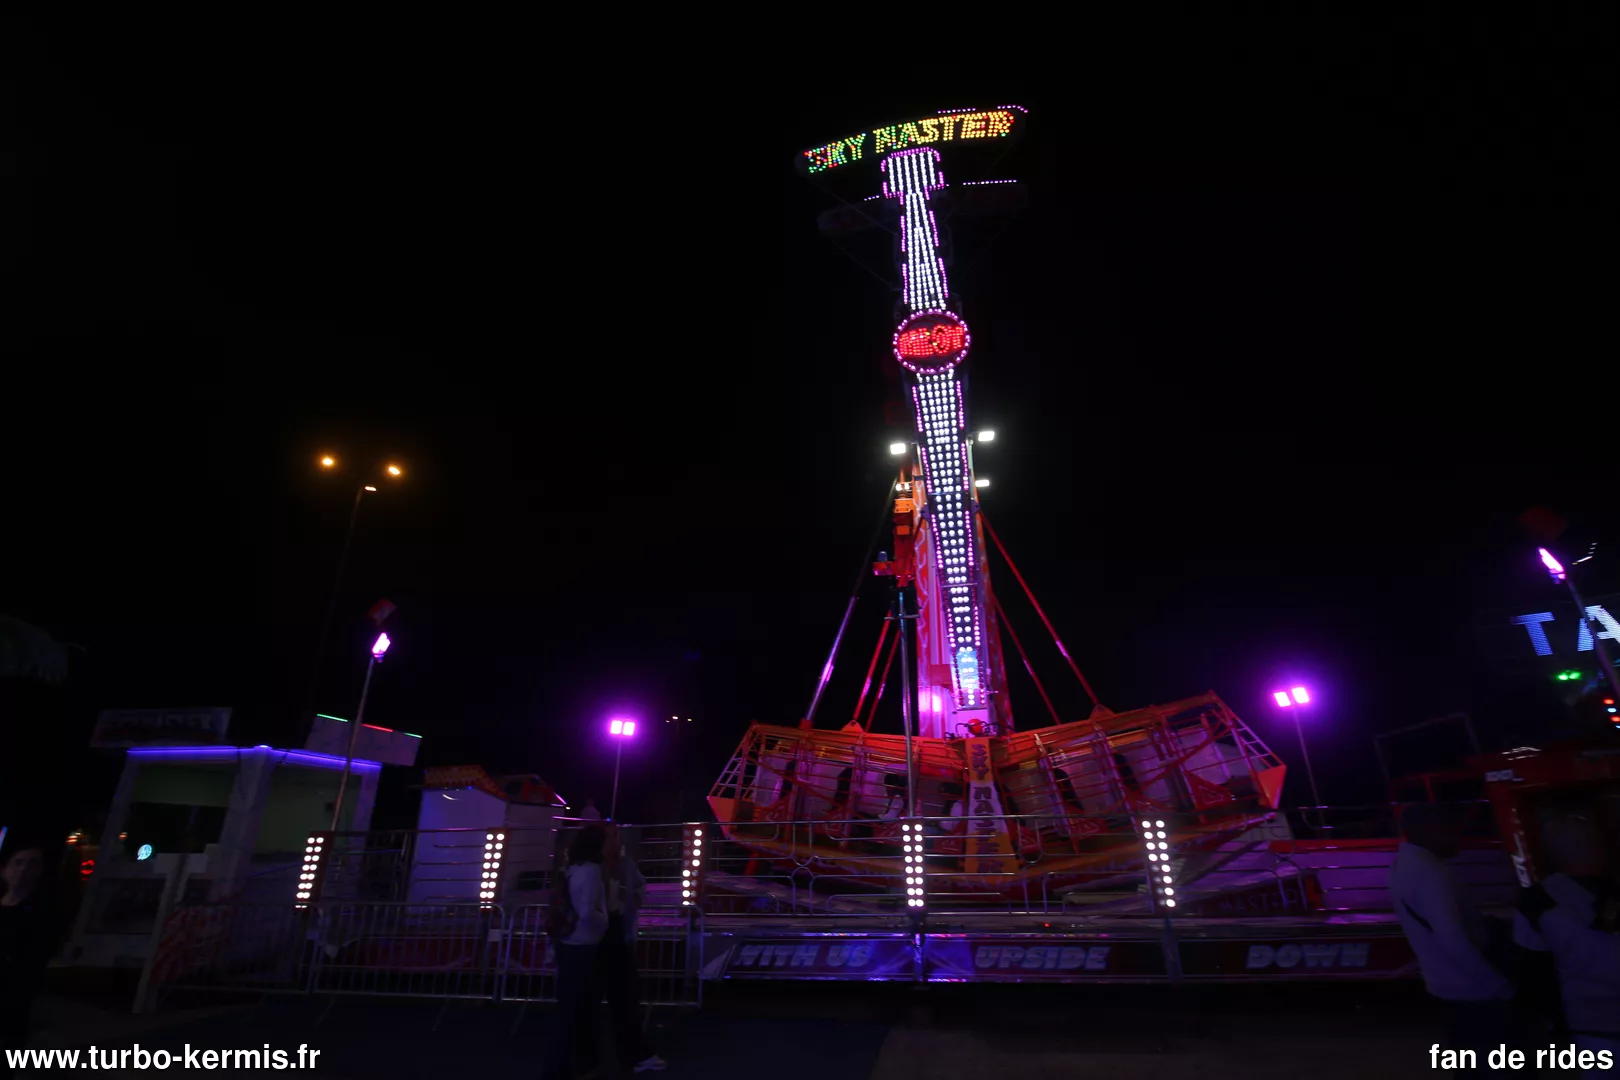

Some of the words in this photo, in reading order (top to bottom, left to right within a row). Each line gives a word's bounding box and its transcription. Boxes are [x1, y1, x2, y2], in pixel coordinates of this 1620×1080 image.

[804, 132, 866, 173] SKY
[872, 110, 1015, 154] MASTER
[826, 942, 873, 967] US
[974, 945, 1112, 970] UPSIDE
[1246, 943, 1371, 969] DOWN
